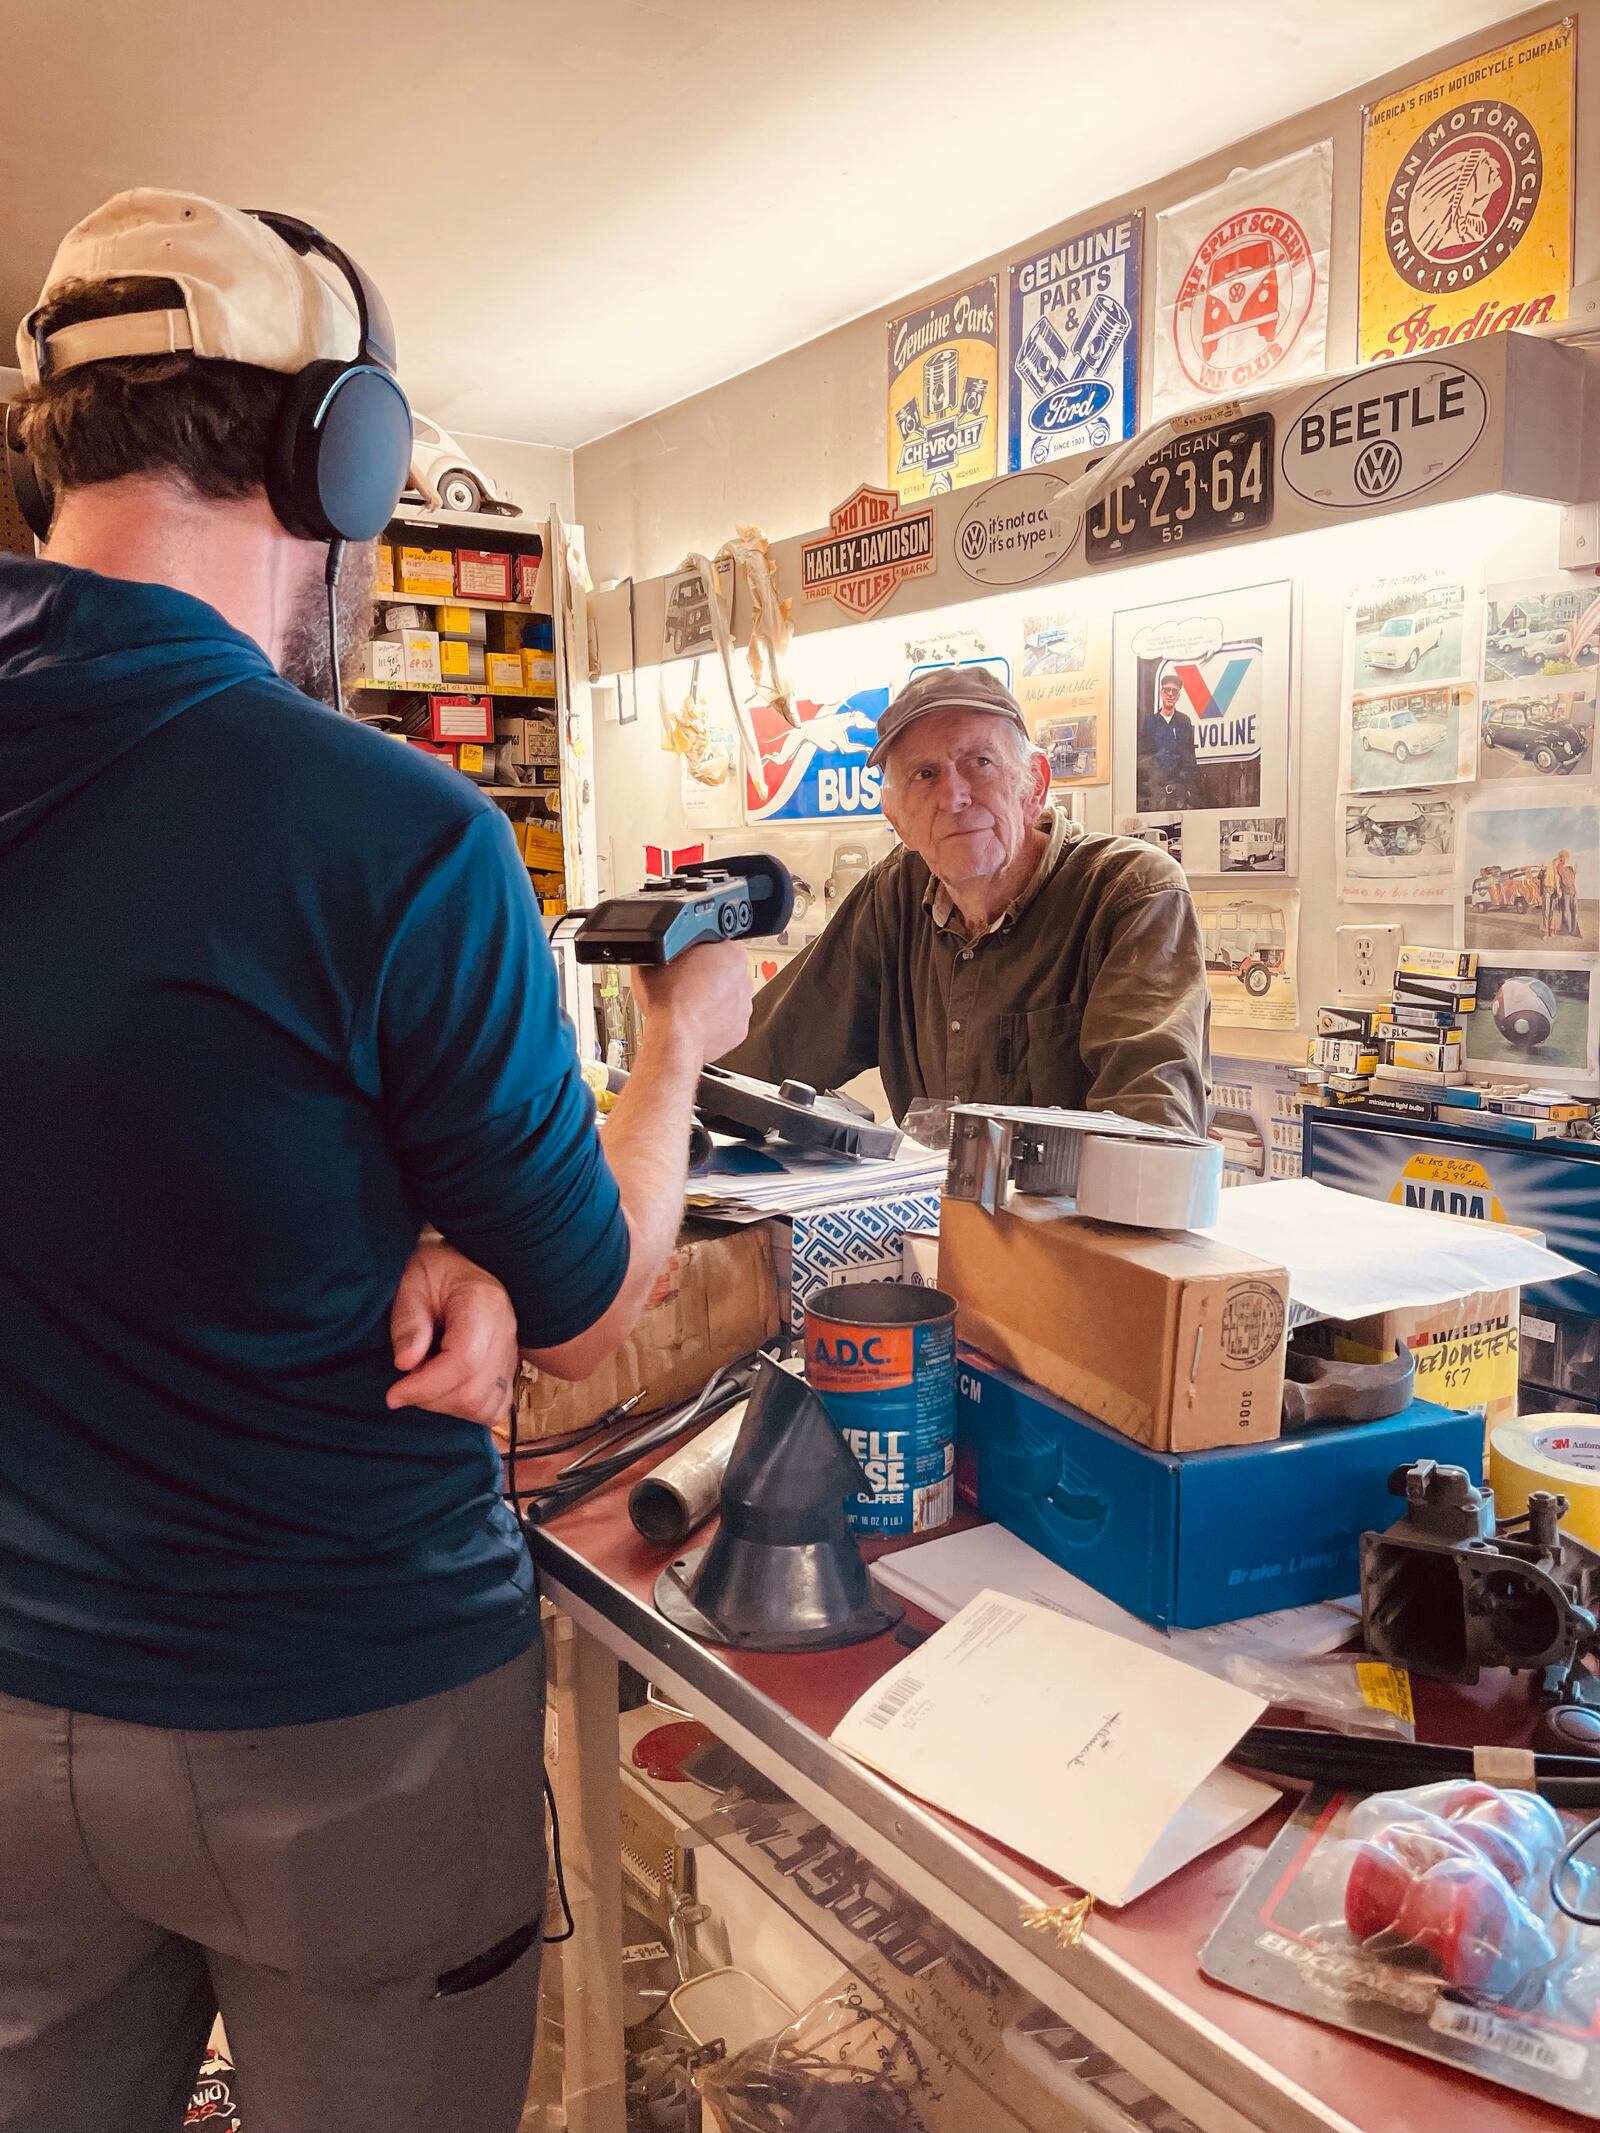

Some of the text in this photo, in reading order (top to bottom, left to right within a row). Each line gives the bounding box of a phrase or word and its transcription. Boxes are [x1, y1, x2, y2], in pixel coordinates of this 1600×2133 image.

[1419, 85, 1445, 107] FIRST
[1448, 56, 1514, 93] MOTORCYCLE
[1519, 35, 1571, 65] COMPANY
[1391, 107, 1536, 271] INDIAN MOTORCYCLE
[1018, 222, 1132, 293] GENUINE
[1179, 214, 1307, 312] THE SPLIT SCREEN
[1433, 256, 1488, 287] 1901
[1040, 266, 1111, 315] PARTS
[893, 296, 994, 371] Genuine Parts
[1064, 307, 1079, 333] &
[1382, 294, 1556, 358] Indian
[1231, 342, 1283, 387] CLUB
[1043, 388, 1095, 429] Ford
[1301, 375, 1466, 456] BEETLE
[904, 426, 980, 464] CHEVROLET
[1053, 441, 1070, 453] SINCE
[1142, 433, 1220, 467] CHIGAN
[837, 494, 889, 533] MOTOR
[989, 515, 1004, 535] it's
[1006, 511, 1025, 530] not
[1027, 511, 1036, 524] a
[806, 521, 930, 582] HARLEY-DAVIDSON
[989, 534, 1004, 554] it's
[1006, 536, 1014, 549] a
[1017, 528, 1046, 551] type
[1162, 524, 1184, 543] 53
[805, 561, 930, 600] TRADE MARK
[839, 573, 891, 609] CYCLES
[1024, 679, 1099, 703] NOW AVAILABLE
[818, 765, 880, 811] BUS
[1391, 1028, 1408, 1038] BLK
[1447, 1160, 1475, 1173] BULBS
[1444, 1368, 1470, 1389] 957
[1239, 1391, 1252, 1427] 3006
[1552, 1438, 1570, 1449] 3M
[1228, 1564, 1283, 1586] Brake
